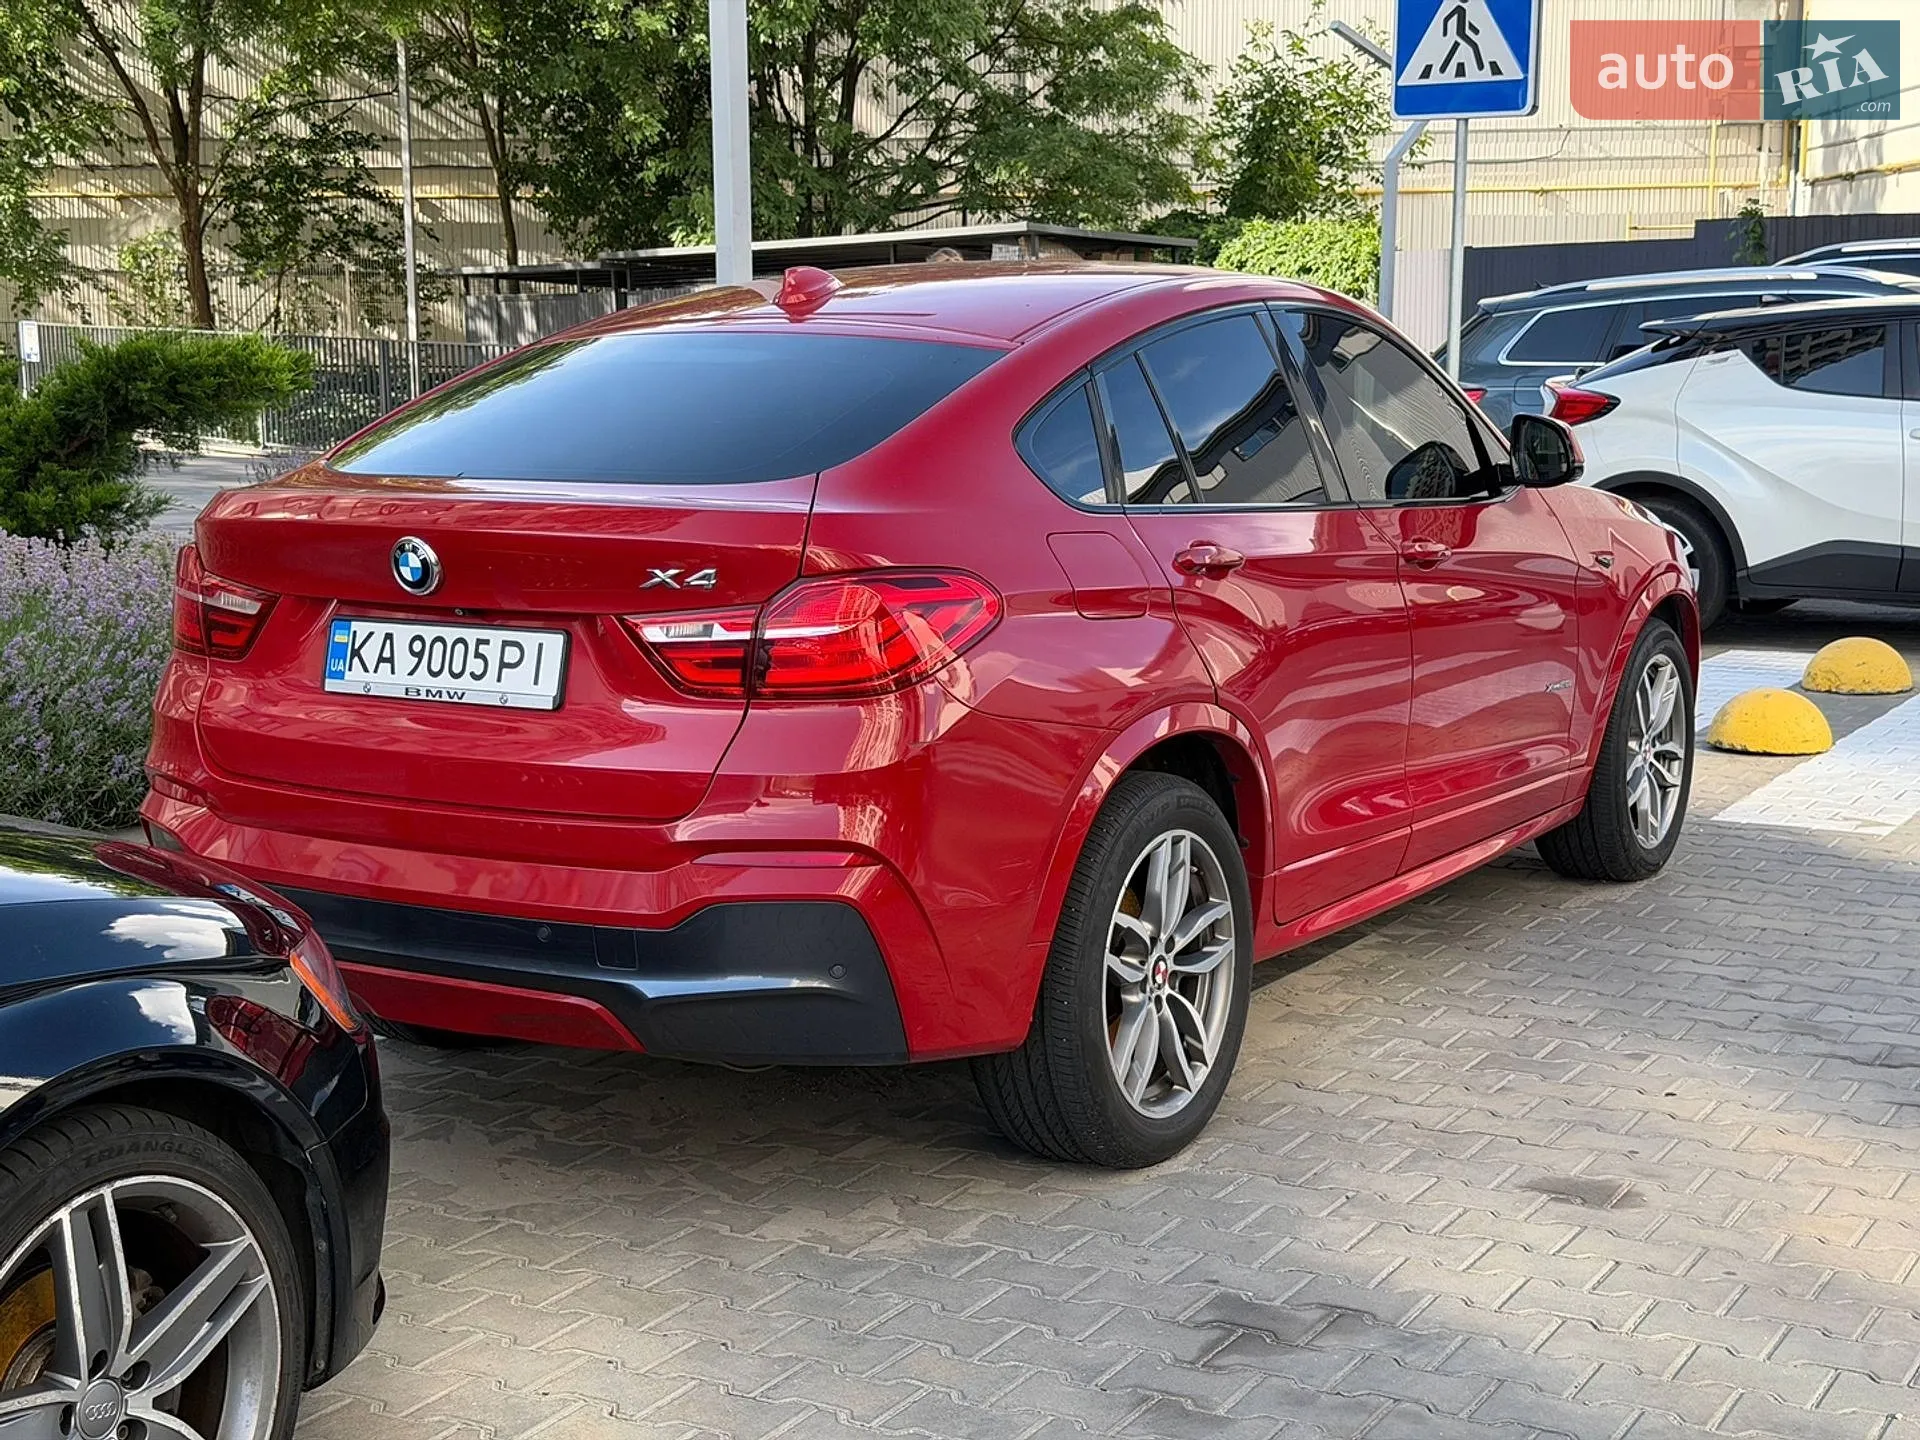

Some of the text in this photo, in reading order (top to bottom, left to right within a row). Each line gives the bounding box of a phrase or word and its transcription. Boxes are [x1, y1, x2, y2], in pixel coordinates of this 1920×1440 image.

[639, 568, 717, 590] X4
[347, 630, 396, 675] KA
[406, 635, 490, 681] 9005
[330, 662, 345, 672] UA
[404, 686, 466, 700] BMW
[82, 1140, 204, 1168] TRIANGLE
